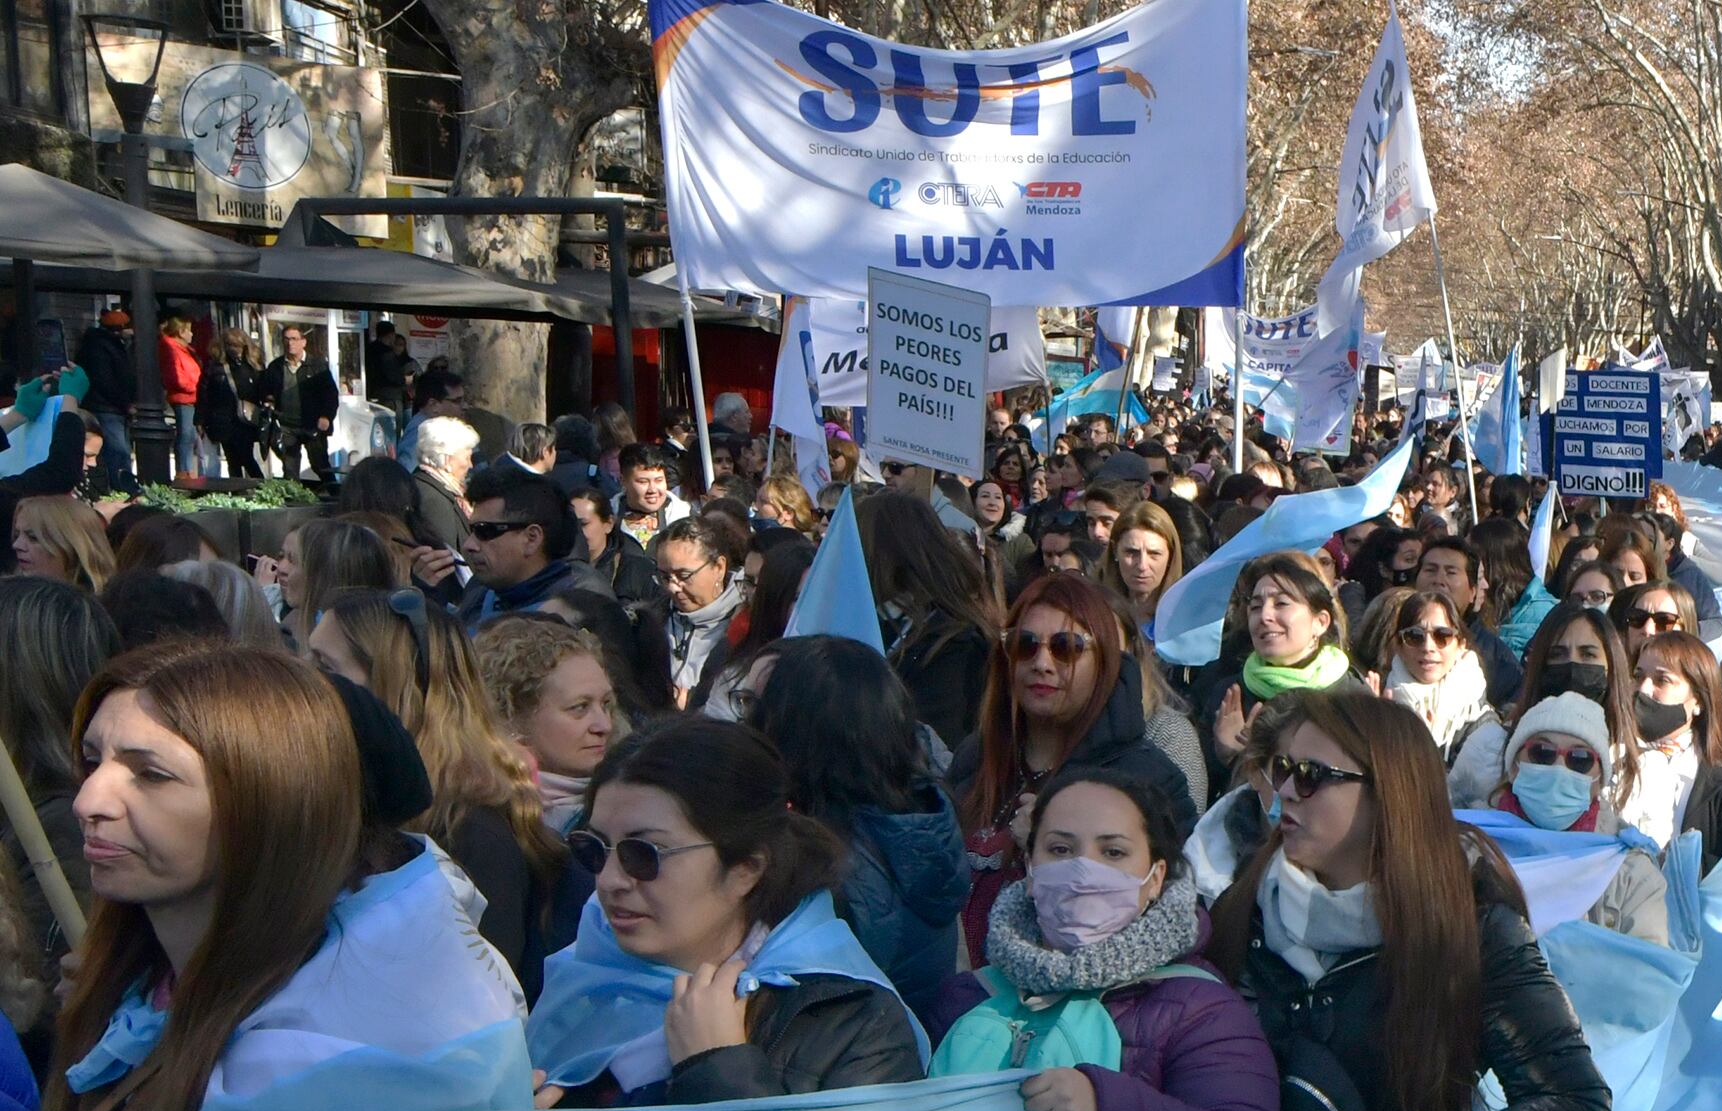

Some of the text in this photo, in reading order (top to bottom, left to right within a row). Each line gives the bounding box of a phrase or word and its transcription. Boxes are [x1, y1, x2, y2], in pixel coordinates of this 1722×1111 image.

[799, 30, 1136, 137] SUTE
[808, 142, 873, 160] Sindicato
[877, 148, 914, 162] Unido
[918, 150, 936, 162] de
[1027, 152, 1044, 164] de
[1047, 152, 1059, 164] la
[1063, 149, 1131, 165] Educación
[215, 193, 283, 222] Lencería
[918, 181, 1004, 209] CTERA
[1026, 205, 1082, 216] Mendoza
[894, 228, 1054, 270] LUJÁN
[876, 302, 944, 333] SOMOS
[949, 320, 983, 343] LOS
[895, 335, 962, 367] PEORES
[879, 358, 976, 399] PAGOS DEL
[1248, 360, 1294, 374] CAPITA
[1590, 378, 1649, 392] DOCENTES
[898, 391, 955, 422] PAÍS!!!
[1560, 397, 1645, 411] DE MENDOZA
[1556, 418, 1648, 435] UCHAMOS POR
[883, 436, 970, 467] SANTA ROSA PRESENTE
[1566, 442, 1643, 457] UN SALARIO
[1562, 472, 1645, 493] DIGNO!!!
